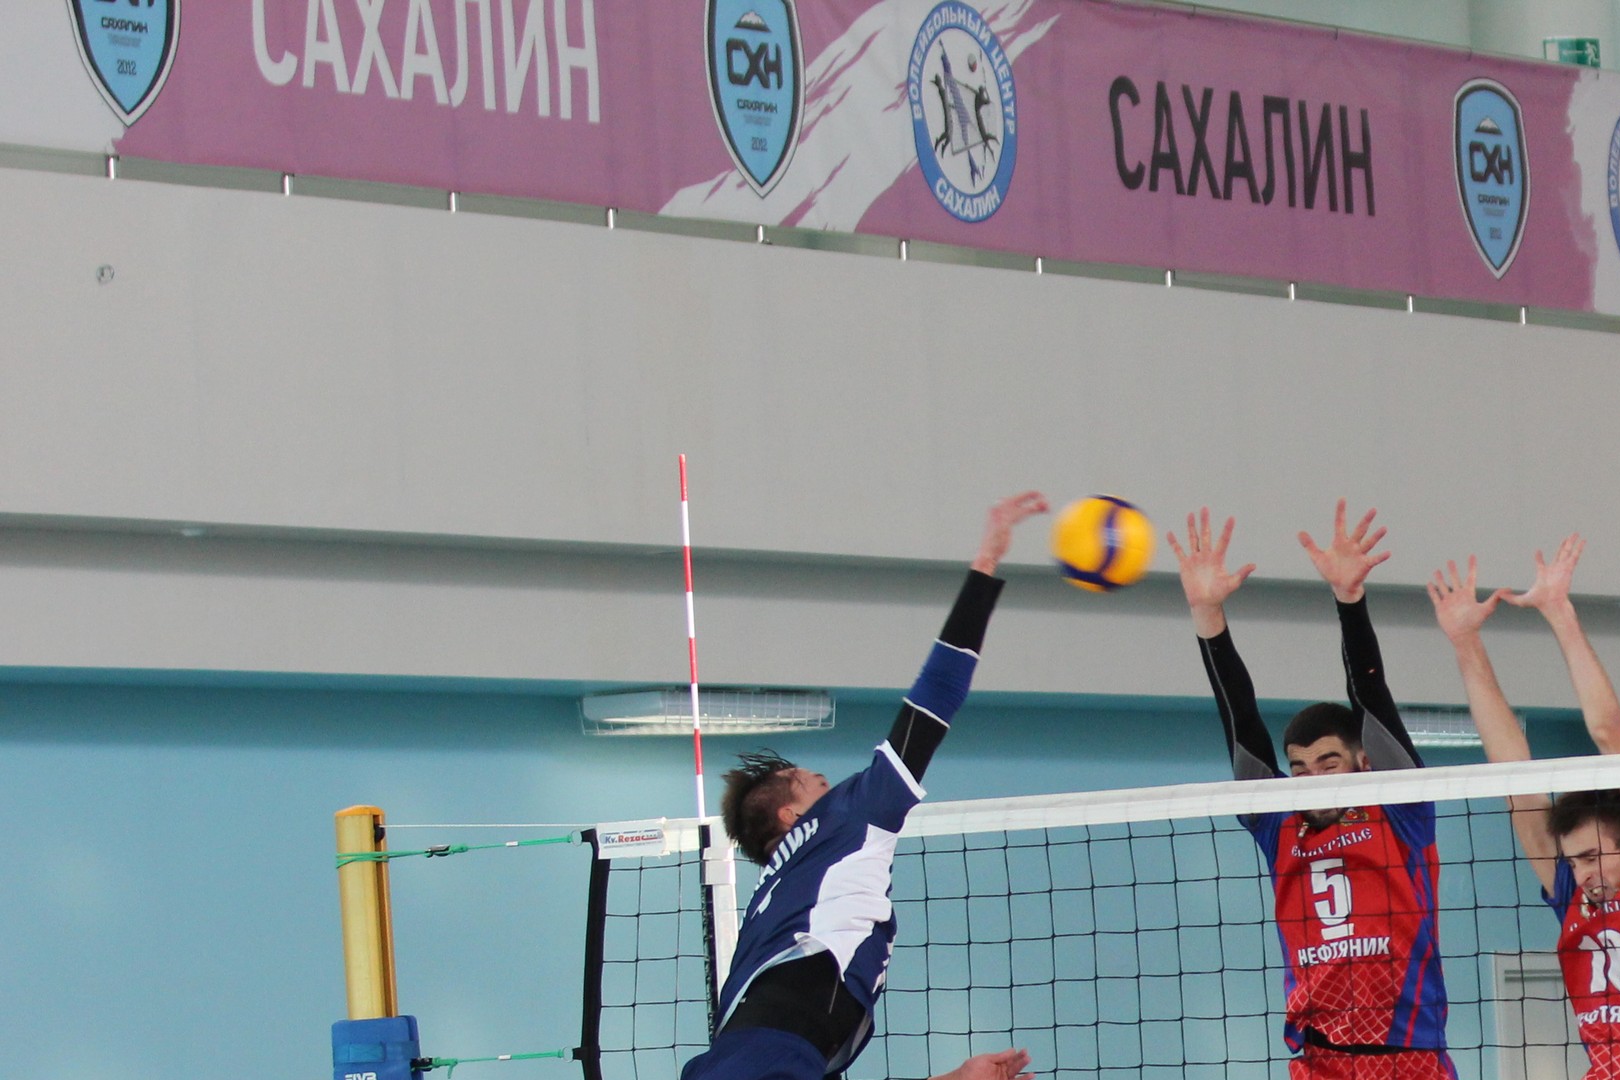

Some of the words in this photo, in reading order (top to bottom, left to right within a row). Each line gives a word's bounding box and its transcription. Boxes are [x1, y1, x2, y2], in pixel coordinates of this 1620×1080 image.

[242, 0, 600, 123] САХАЛИН
[990, 50, 1016, 135] ЦЕНТР
[1109, 76, 1376, 216] САХАЛИН
[936, 178, 1000, 218] САХАЛИН
[1309, 858, 1352, 926] 5
[1298, 936, 1390, 966] НЕФТЯНИК
